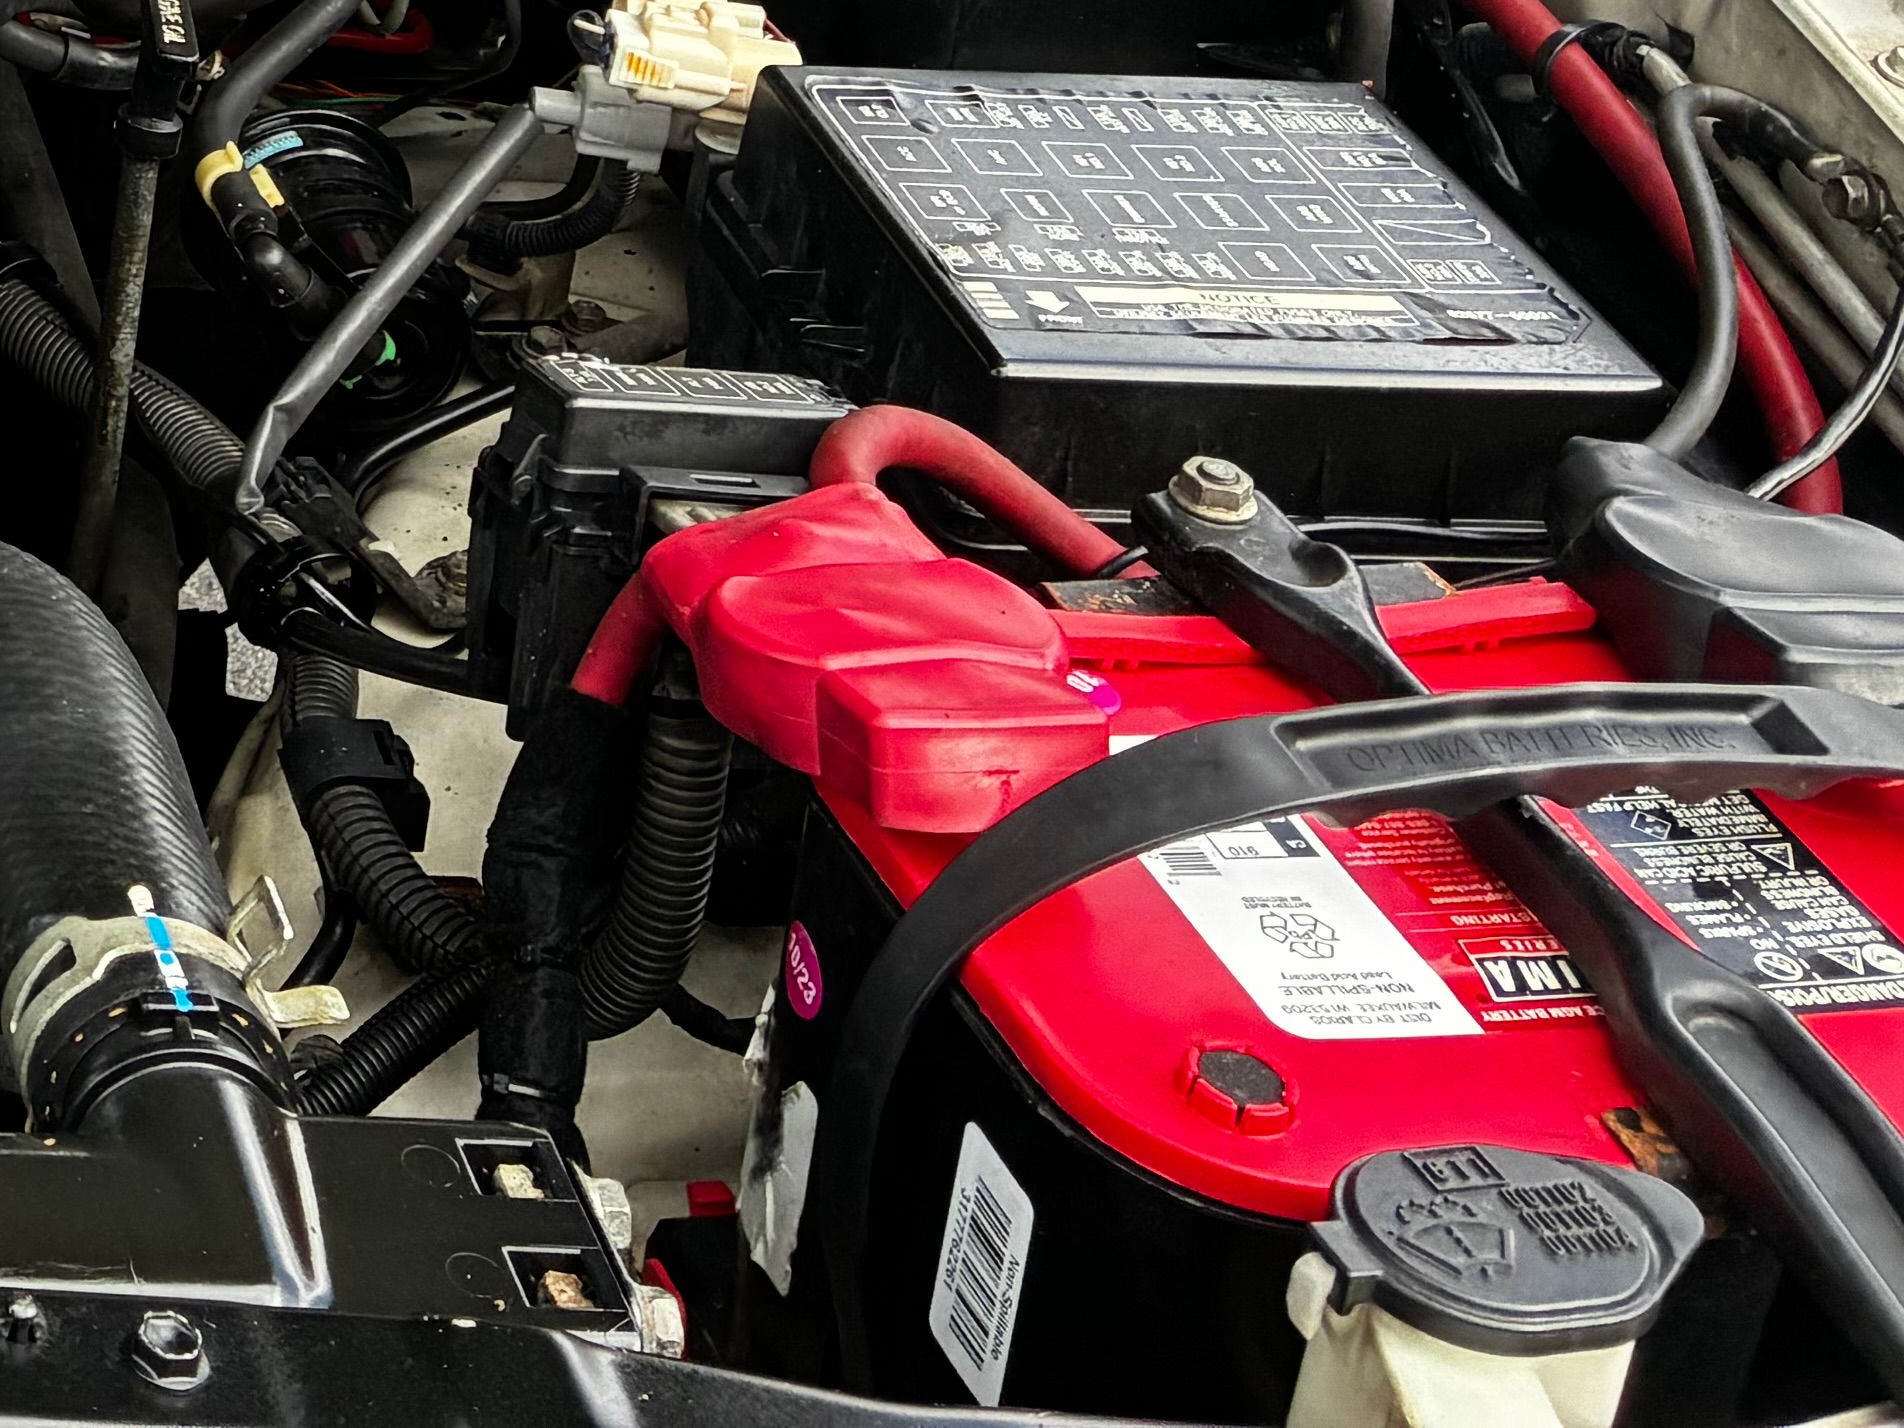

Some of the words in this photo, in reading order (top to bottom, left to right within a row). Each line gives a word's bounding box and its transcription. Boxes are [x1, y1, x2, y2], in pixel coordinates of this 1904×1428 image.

[161, 24, 186, 44] OIL
[1198, 292, 1282, 306] NOTICE
[1345, 738, 1480, 772] OPTIMA
[1667, 724, 1737, 750] INC.
[1587, 802, 1623, 814] FAST
[1624, 799, 1659, 812] HELP
[1677, 815, 1769, 828] IMMEDIATELY
[1692, 827, 1730, 837] EYES
[1731, 825, 1779, 836] FLUSH
[1228, 846, 1260, 857] 910
[1634, 868, 1663, 878] CAN
[1664, 865, 1697, 877] ACID
[1698, 860, 1767, 874] SULFURIC
[1760, 886, 1840, 900] BLINDNESS
[1665, 901, 1733, 913] SMOKING
[1771, 898, 1815, 910] CAUSE
[1816, 896, 1849, 907] CAN
[1689, 913, 1744, 926] FLAMES
[1806, 907, 1860, 920] GASES
[1698, 926, 1757, 939] SPARKS
[1782, 918, 1872, 934] EXPLOSIVE
[1829, 930, 1887, 945] SHIELD
[1500, 938, 1562, 951] ERIES
[1750, 938, 1780, 951] NO
[1279, 971, 1329, 982] Battery
[1330, 971, 1359, 981] Acid
[1360, 971, 1393, 980] Lead
[1482, 958, 1582, 993] IMA
[1277, 983, 1416, 997] NON-SPILLABLE
[1334, 1002, 1353, 1013] WI
[1357, 1002, 1442, 1014] MILWAUKEE
[1549, 1006, 1583, 1019] AGM
[1377, 1014, 1395, 1025] BY
[1480, 1007, 1546, 1023] BATTERY
[990, 1253, 1021, 1362] Non-Spillable
